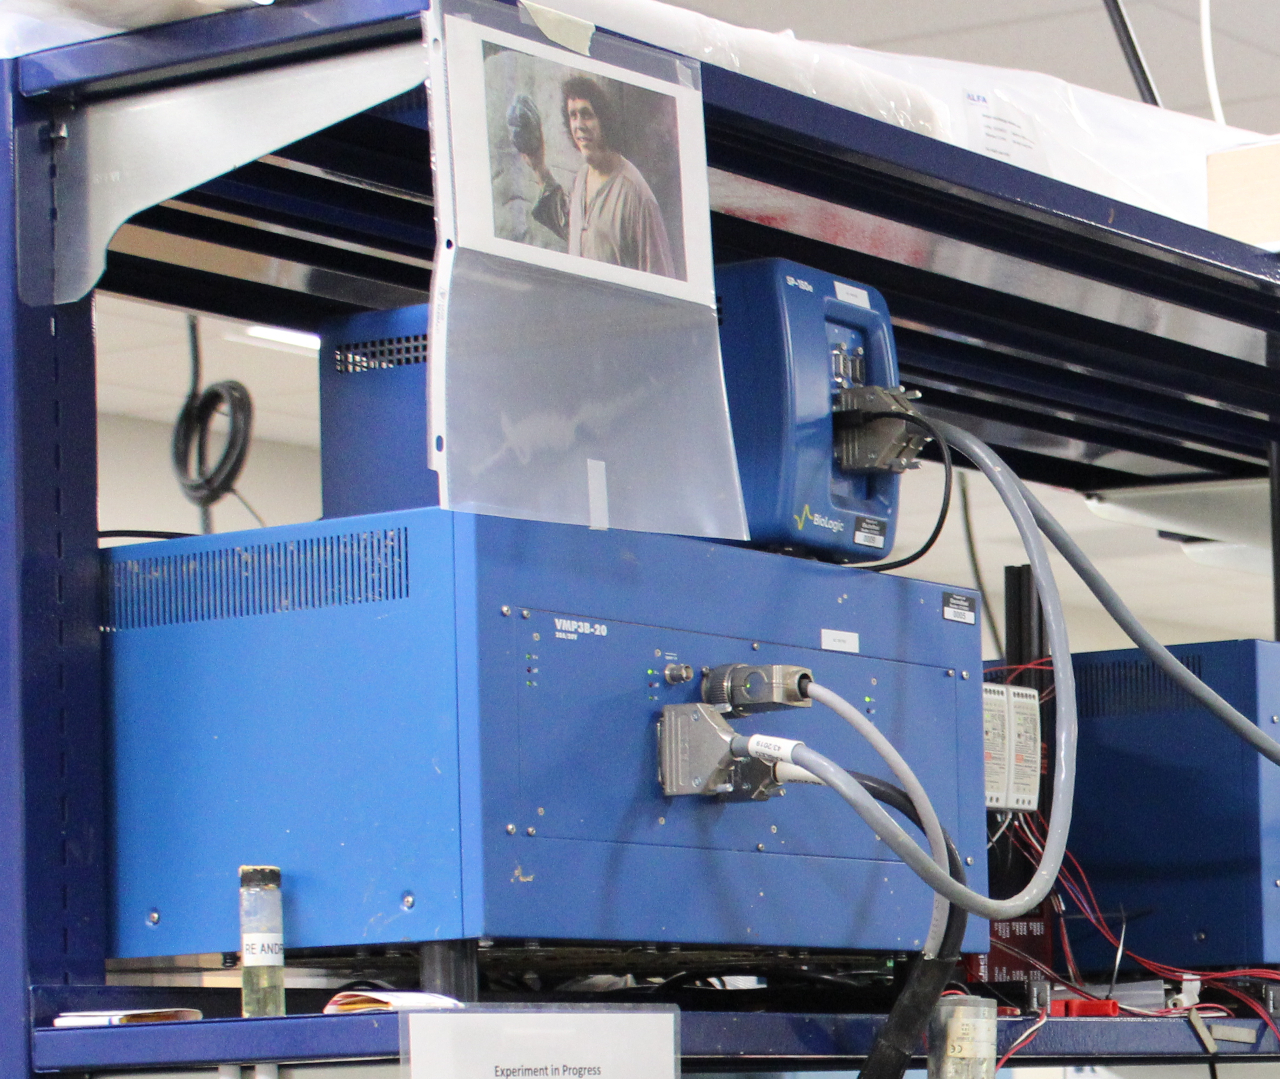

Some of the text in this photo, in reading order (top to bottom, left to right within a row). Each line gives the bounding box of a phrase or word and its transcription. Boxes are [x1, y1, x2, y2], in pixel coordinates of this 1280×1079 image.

[554, 618, 608, 637] VMP3B-20
[494, 1064, 601, 1079] Experiment in Progress
